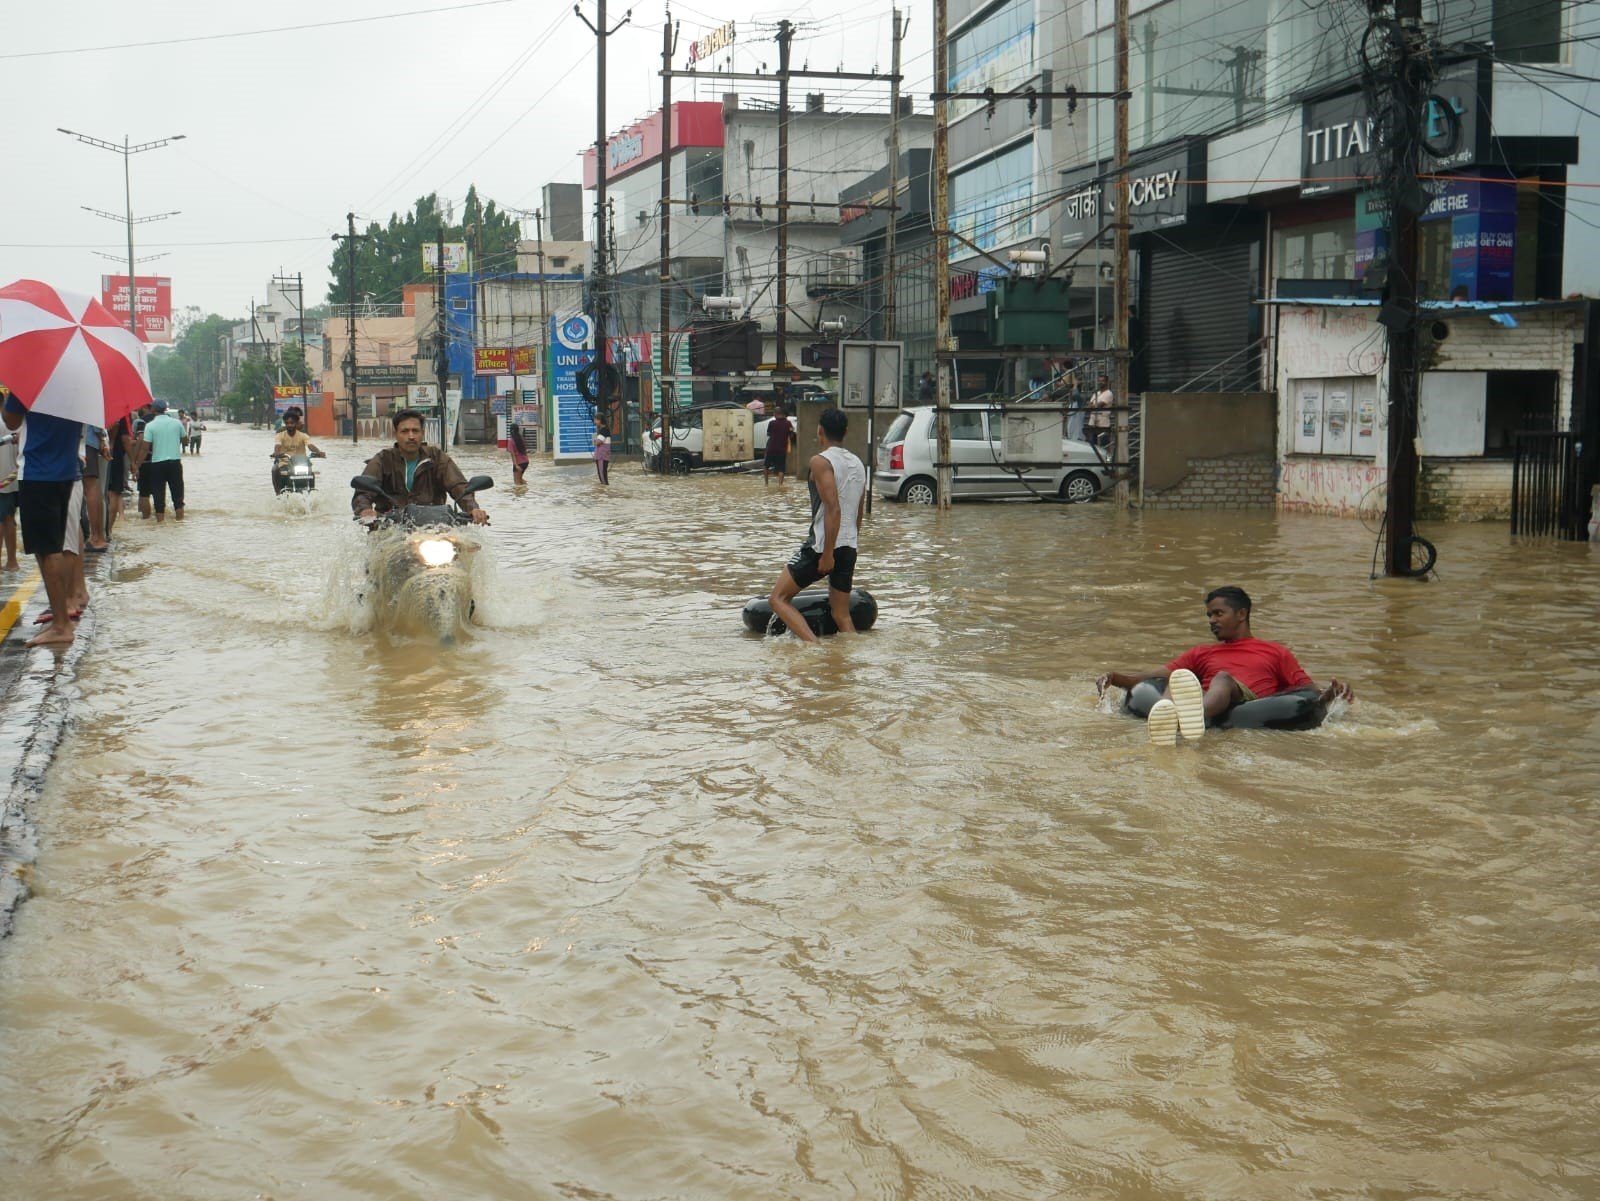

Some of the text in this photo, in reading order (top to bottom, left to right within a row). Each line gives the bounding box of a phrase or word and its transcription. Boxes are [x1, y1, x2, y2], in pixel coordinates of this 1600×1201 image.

[1430, 194, 1469, 215] ONE FREE
[1480, 239, 1513, 248] GET ONE
